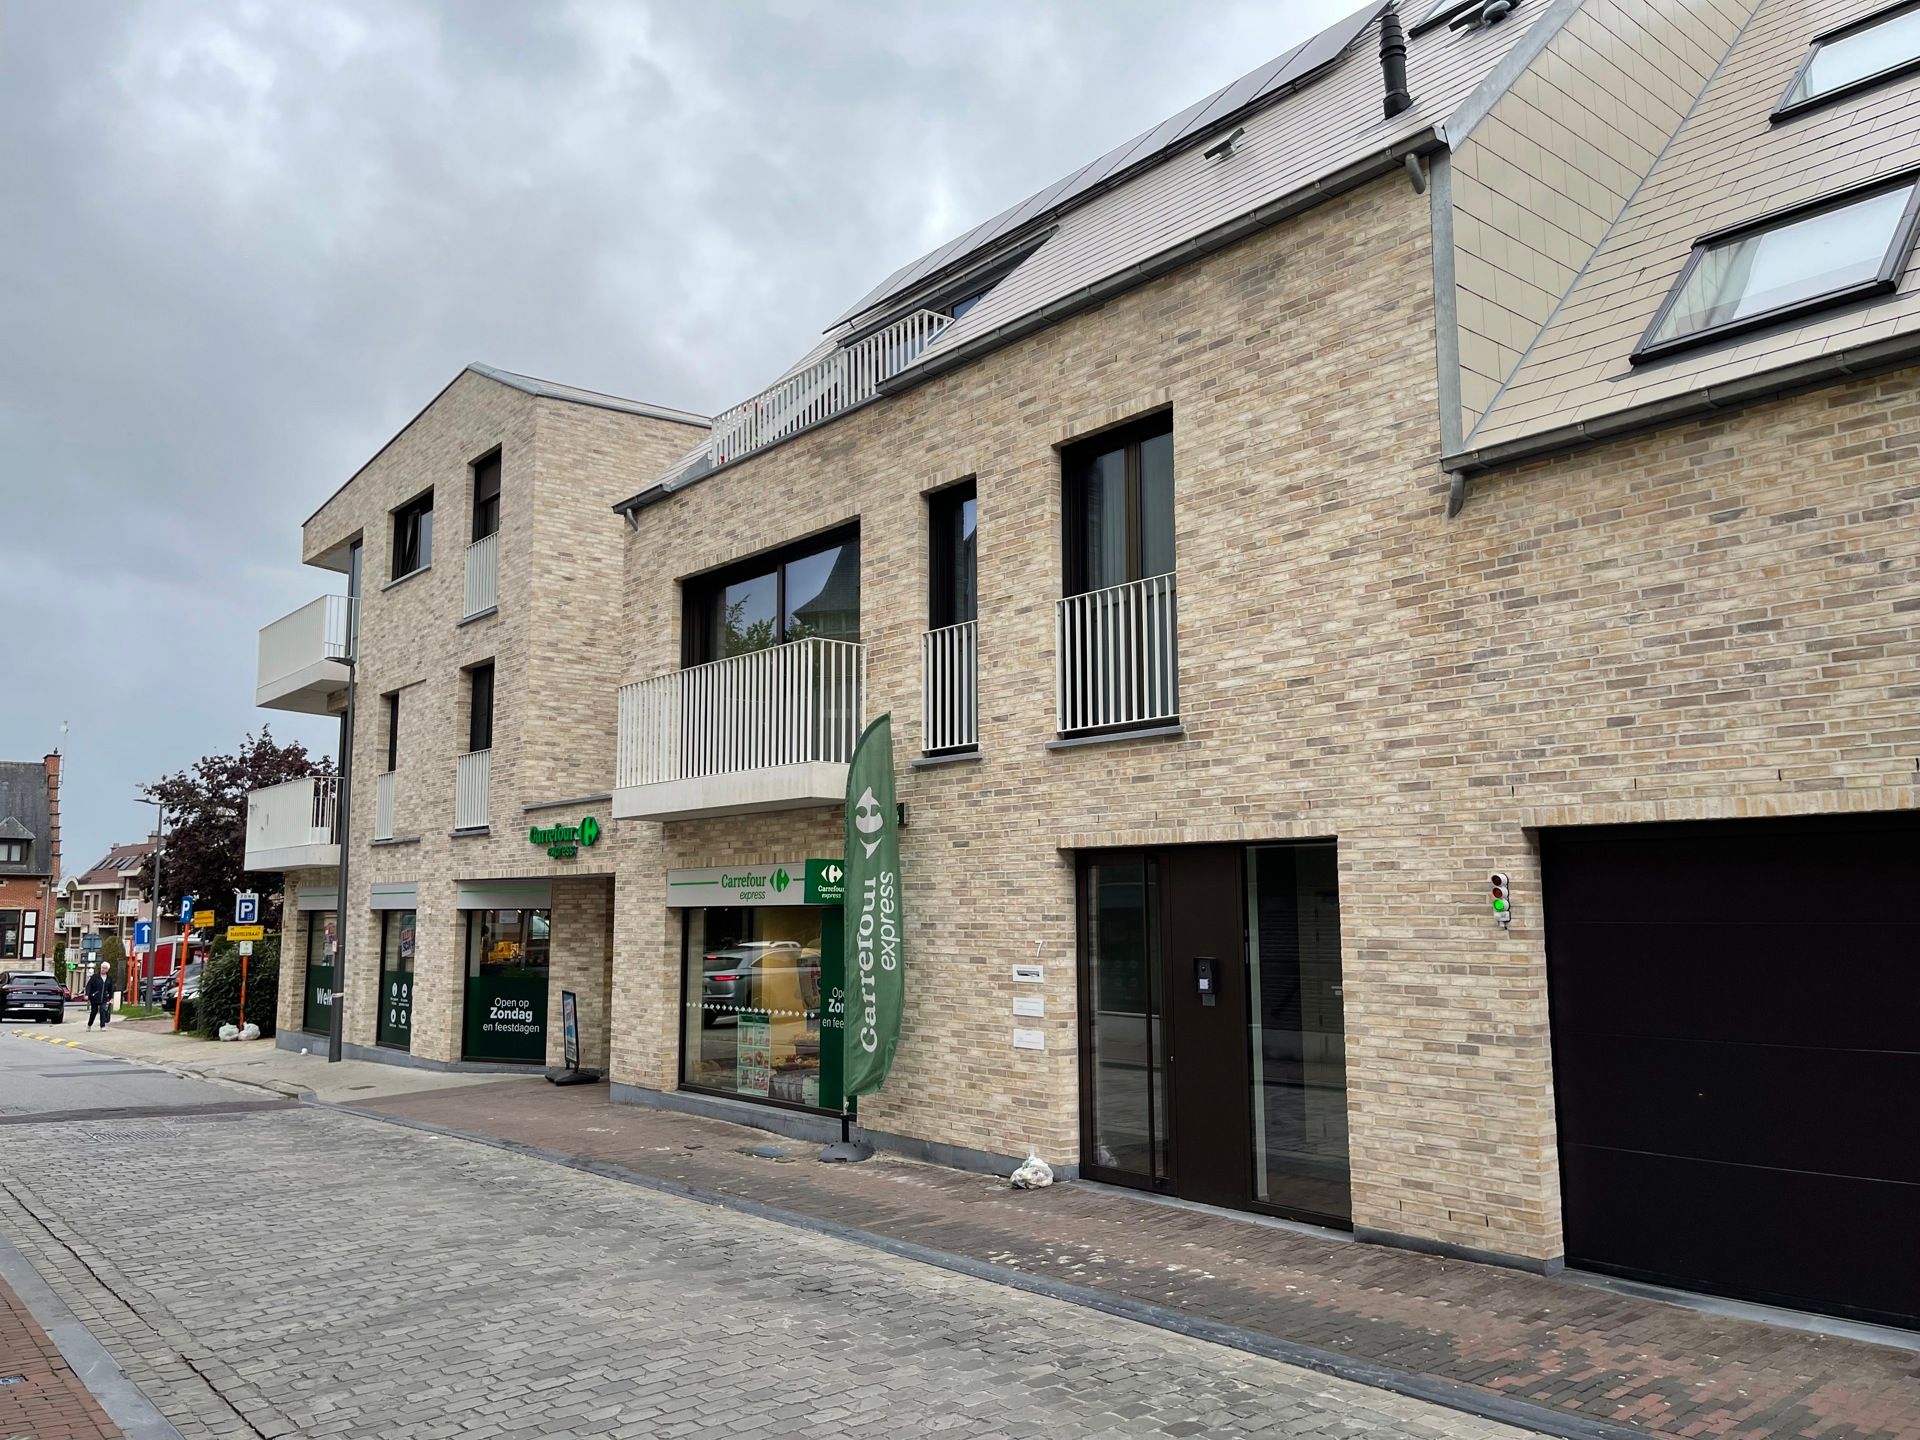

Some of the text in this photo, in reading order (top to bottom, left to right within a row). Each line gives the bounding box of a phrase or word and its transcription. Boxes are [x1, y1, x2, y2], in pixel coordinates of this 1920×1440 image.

[529, 823, 577, 844] Carrefour
[547, 846, 576, 859] express
[721, 872, 767, 889] Carrefour
[740, 890, 766, 902] express
[240, 902, 253, 919] P
[879, 871, 901, 971] express
[1034, 940, 1043, 957] 7
[856, 876, 878, 1053] Carrefour
[494, 997, 530, 1009] Open op
[489, 1007, 533, 1022] Zondag
[482, 1021, 540, 1035] en feestdagen
[822, 1018, 832, 1028] en
